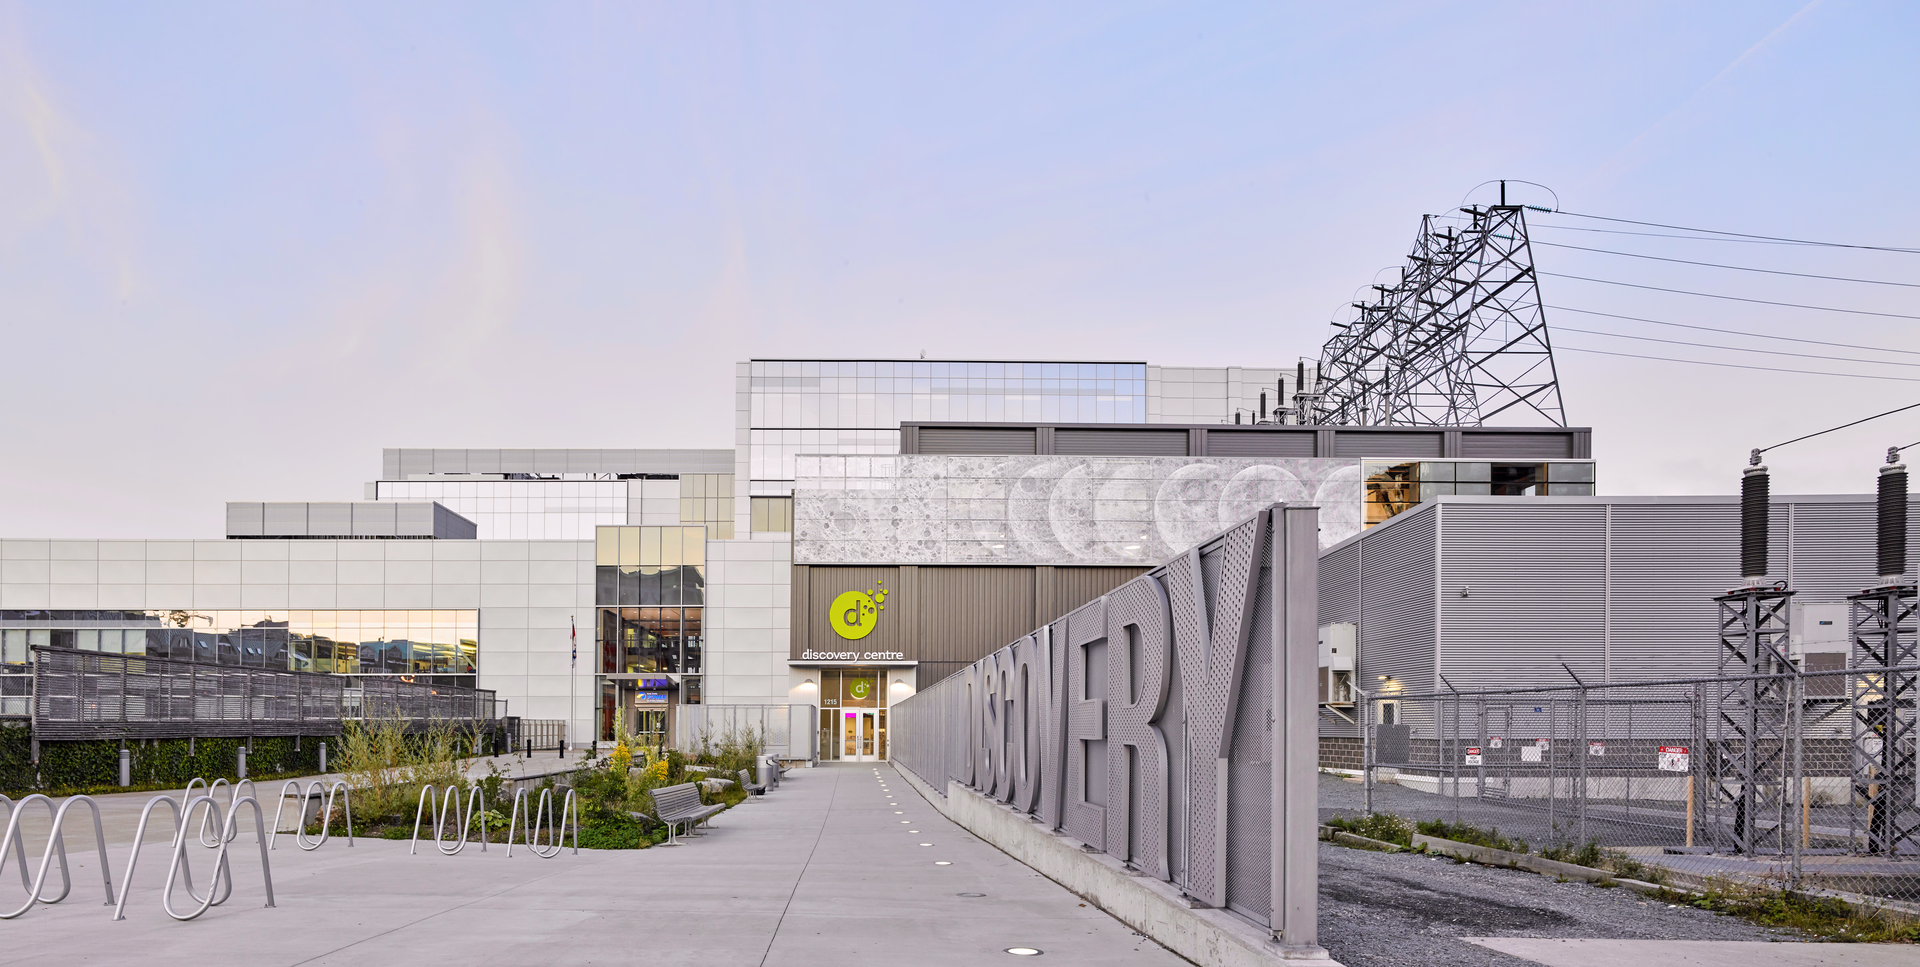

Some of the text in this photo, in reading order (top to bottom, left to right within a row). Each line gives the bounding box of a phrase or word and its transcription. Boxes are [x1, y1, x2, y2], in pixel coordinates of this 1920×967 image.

[801, 648, 904, 663] discovery centre
[964, 510, 1269, 908] DISCOVERY
